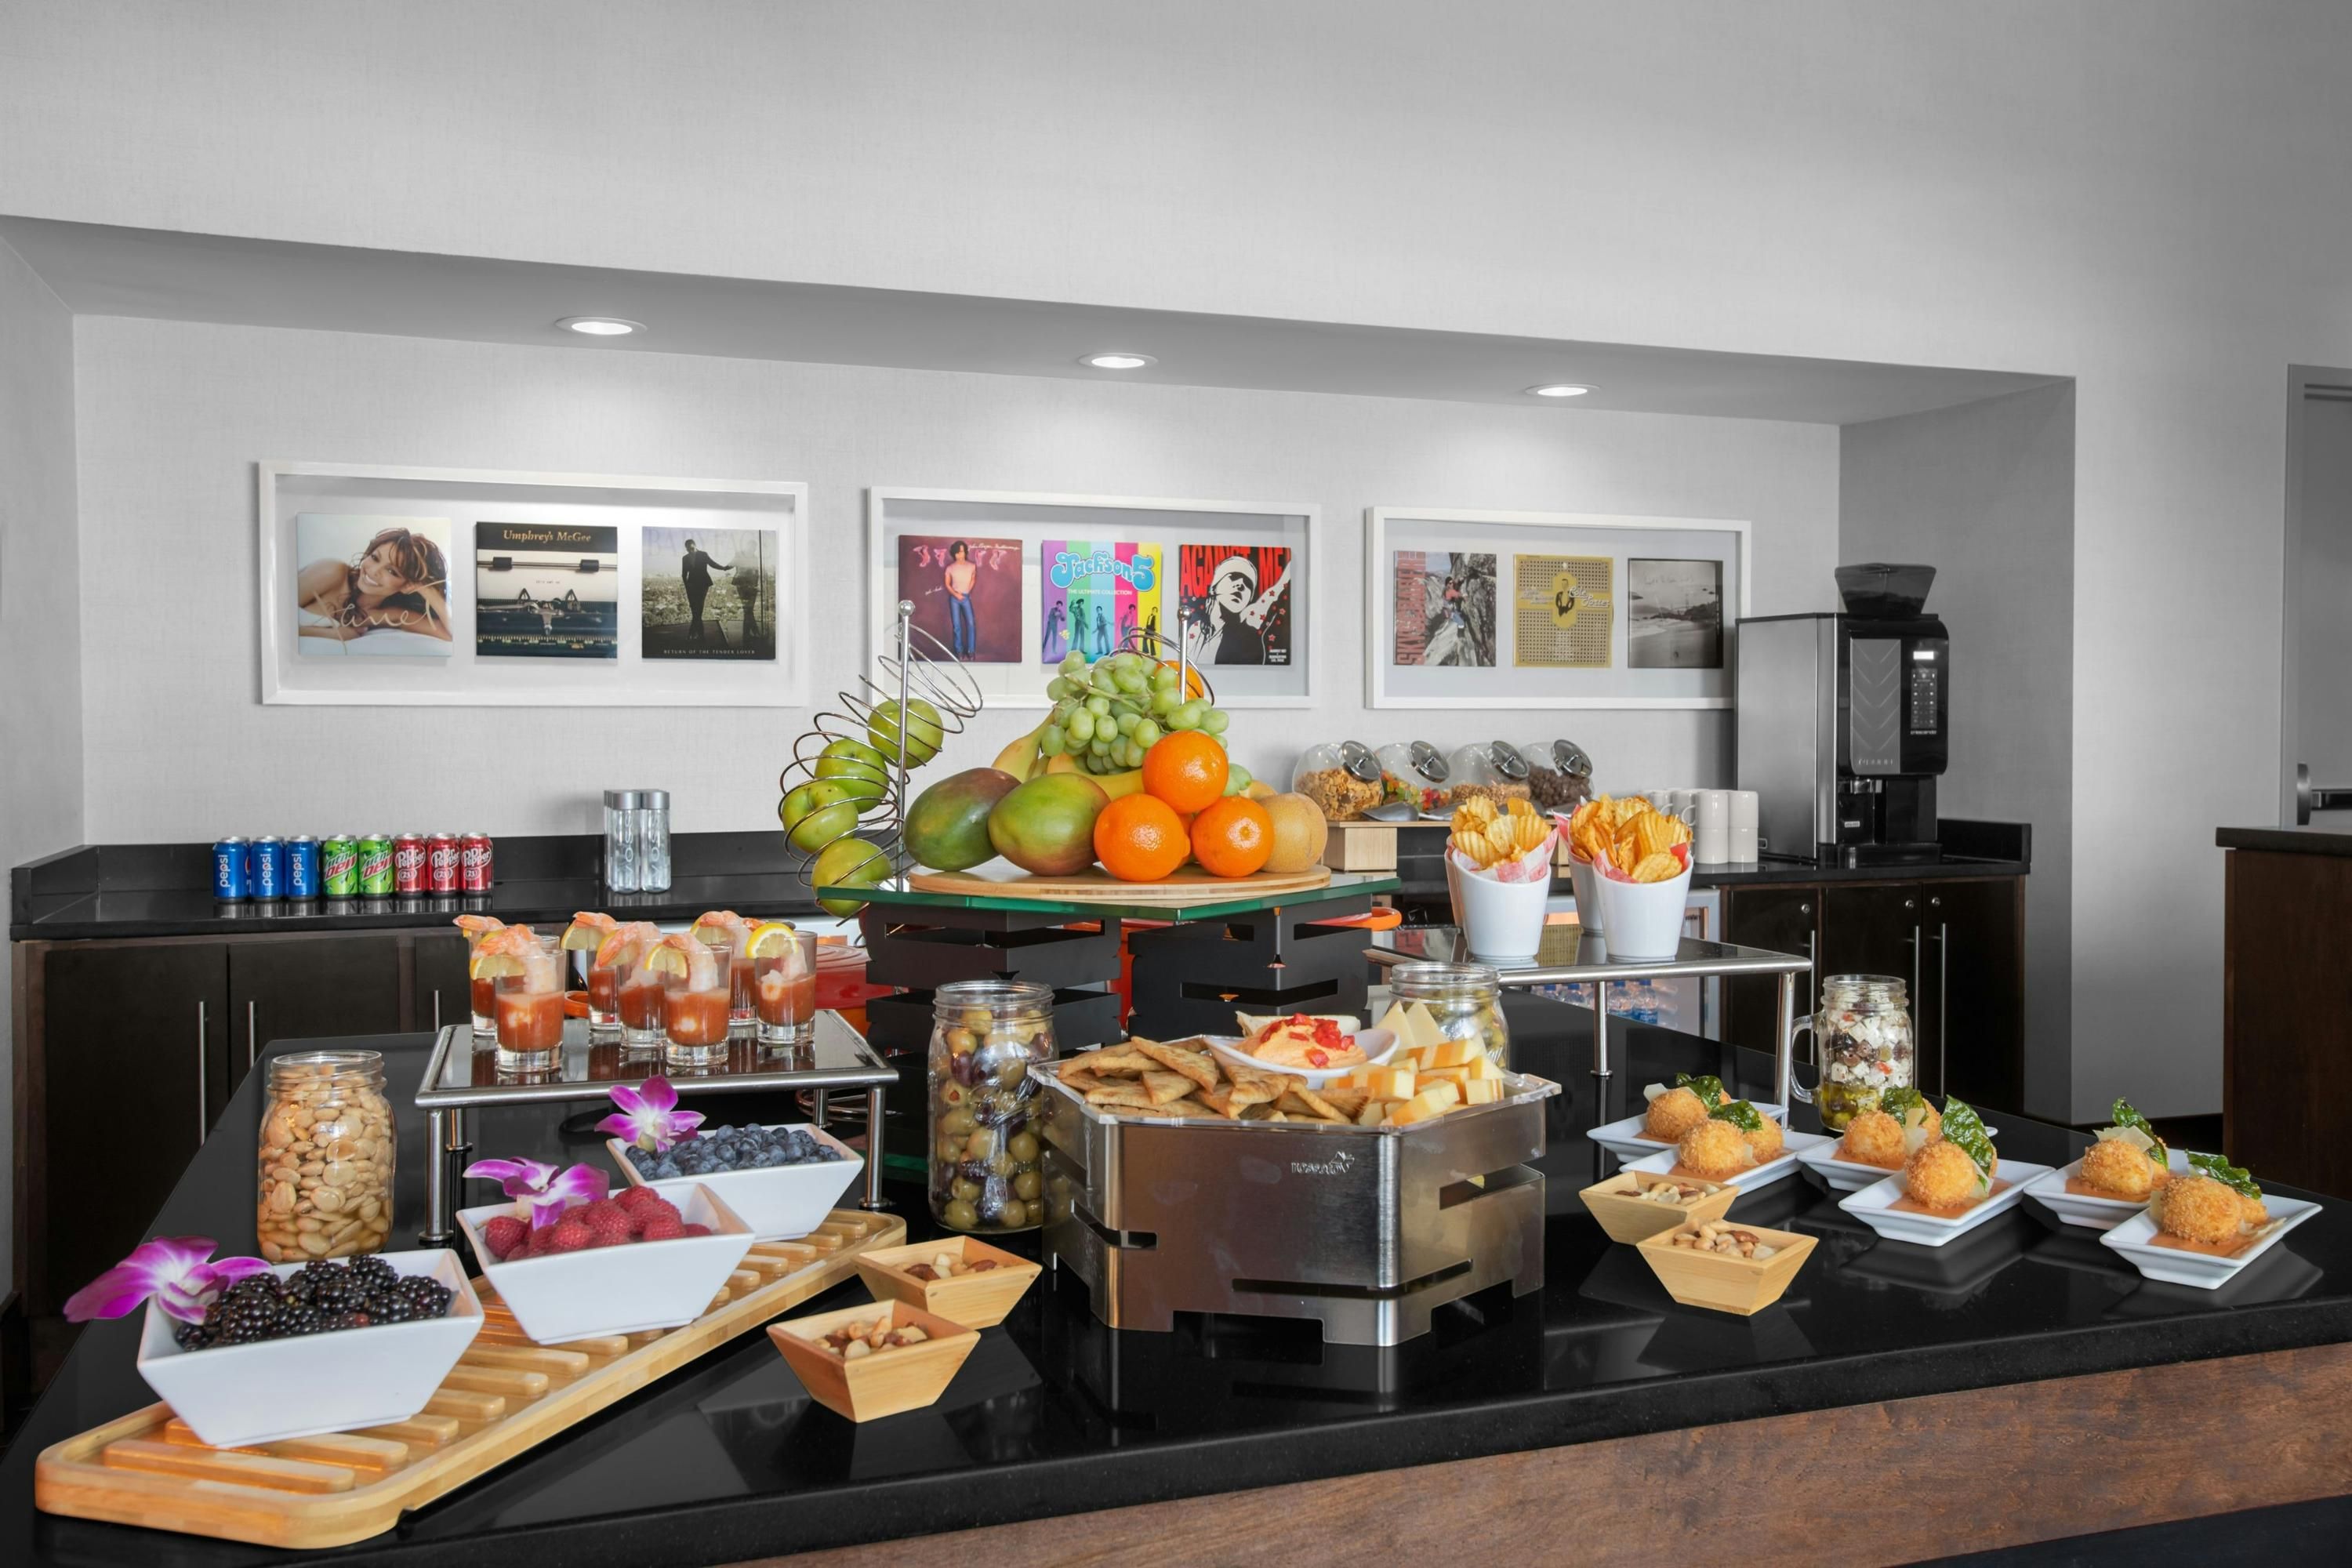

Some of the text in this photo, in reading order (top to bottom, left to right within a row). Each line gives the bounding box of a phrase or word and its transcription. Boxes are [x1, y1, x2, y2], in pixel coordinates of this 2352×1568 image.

[503, 529, 591, 543] Umphrey's McGee
[1051, 551, 1155, 592] Jackson 5
[398, 851, 424, 868] Pepper
[406, 848, 419, 858] Dr
[434, 851, 459, 868] Pepper
[443, 848, 455, 858] Dr
[463, 851, 490, 867] Pepper
[470, 848, 483, 857] Dr
[218, 854, 230, 888] pepsi
[260, 853, 274, 887] pepsi
[291, 853, 305, 887] pepsi
